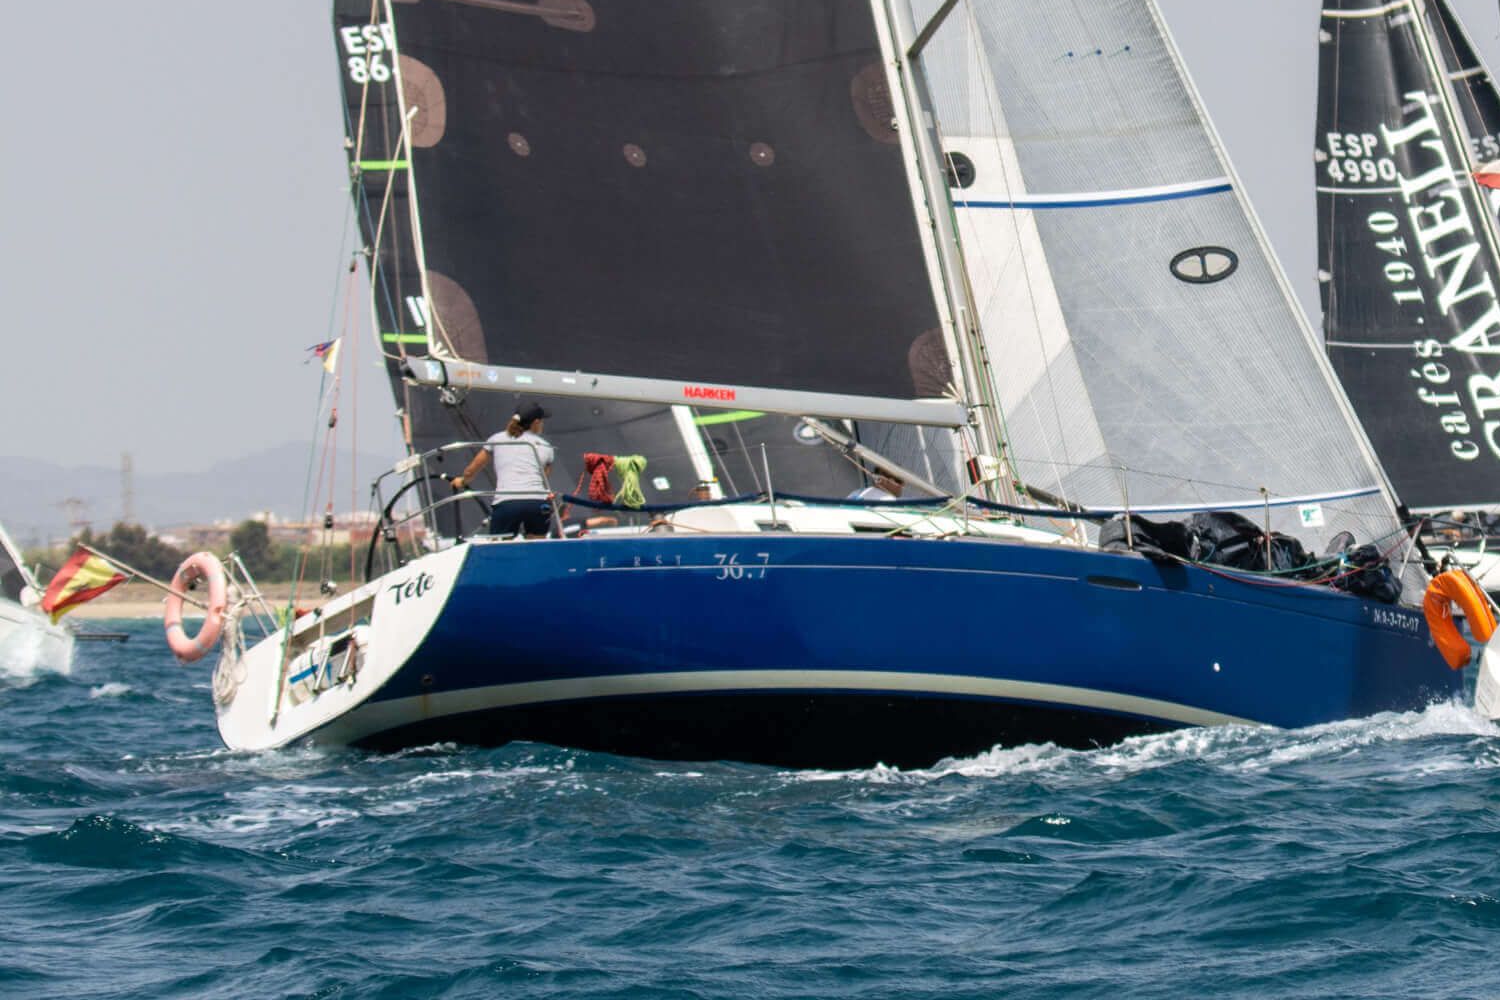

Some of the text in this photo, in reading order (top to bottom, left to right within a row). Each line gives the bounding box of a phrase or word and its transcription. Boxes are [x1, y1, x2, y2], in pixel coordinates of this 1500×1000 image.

[1326, 132, 1378, 158] ESP
[1326, 157, 1397, 183] 4990
[1368, 210, 1480, 460] cafés 1940
[685, 386, 735, 400] HARKEN
[713, 553, 769, 580] 36.7
